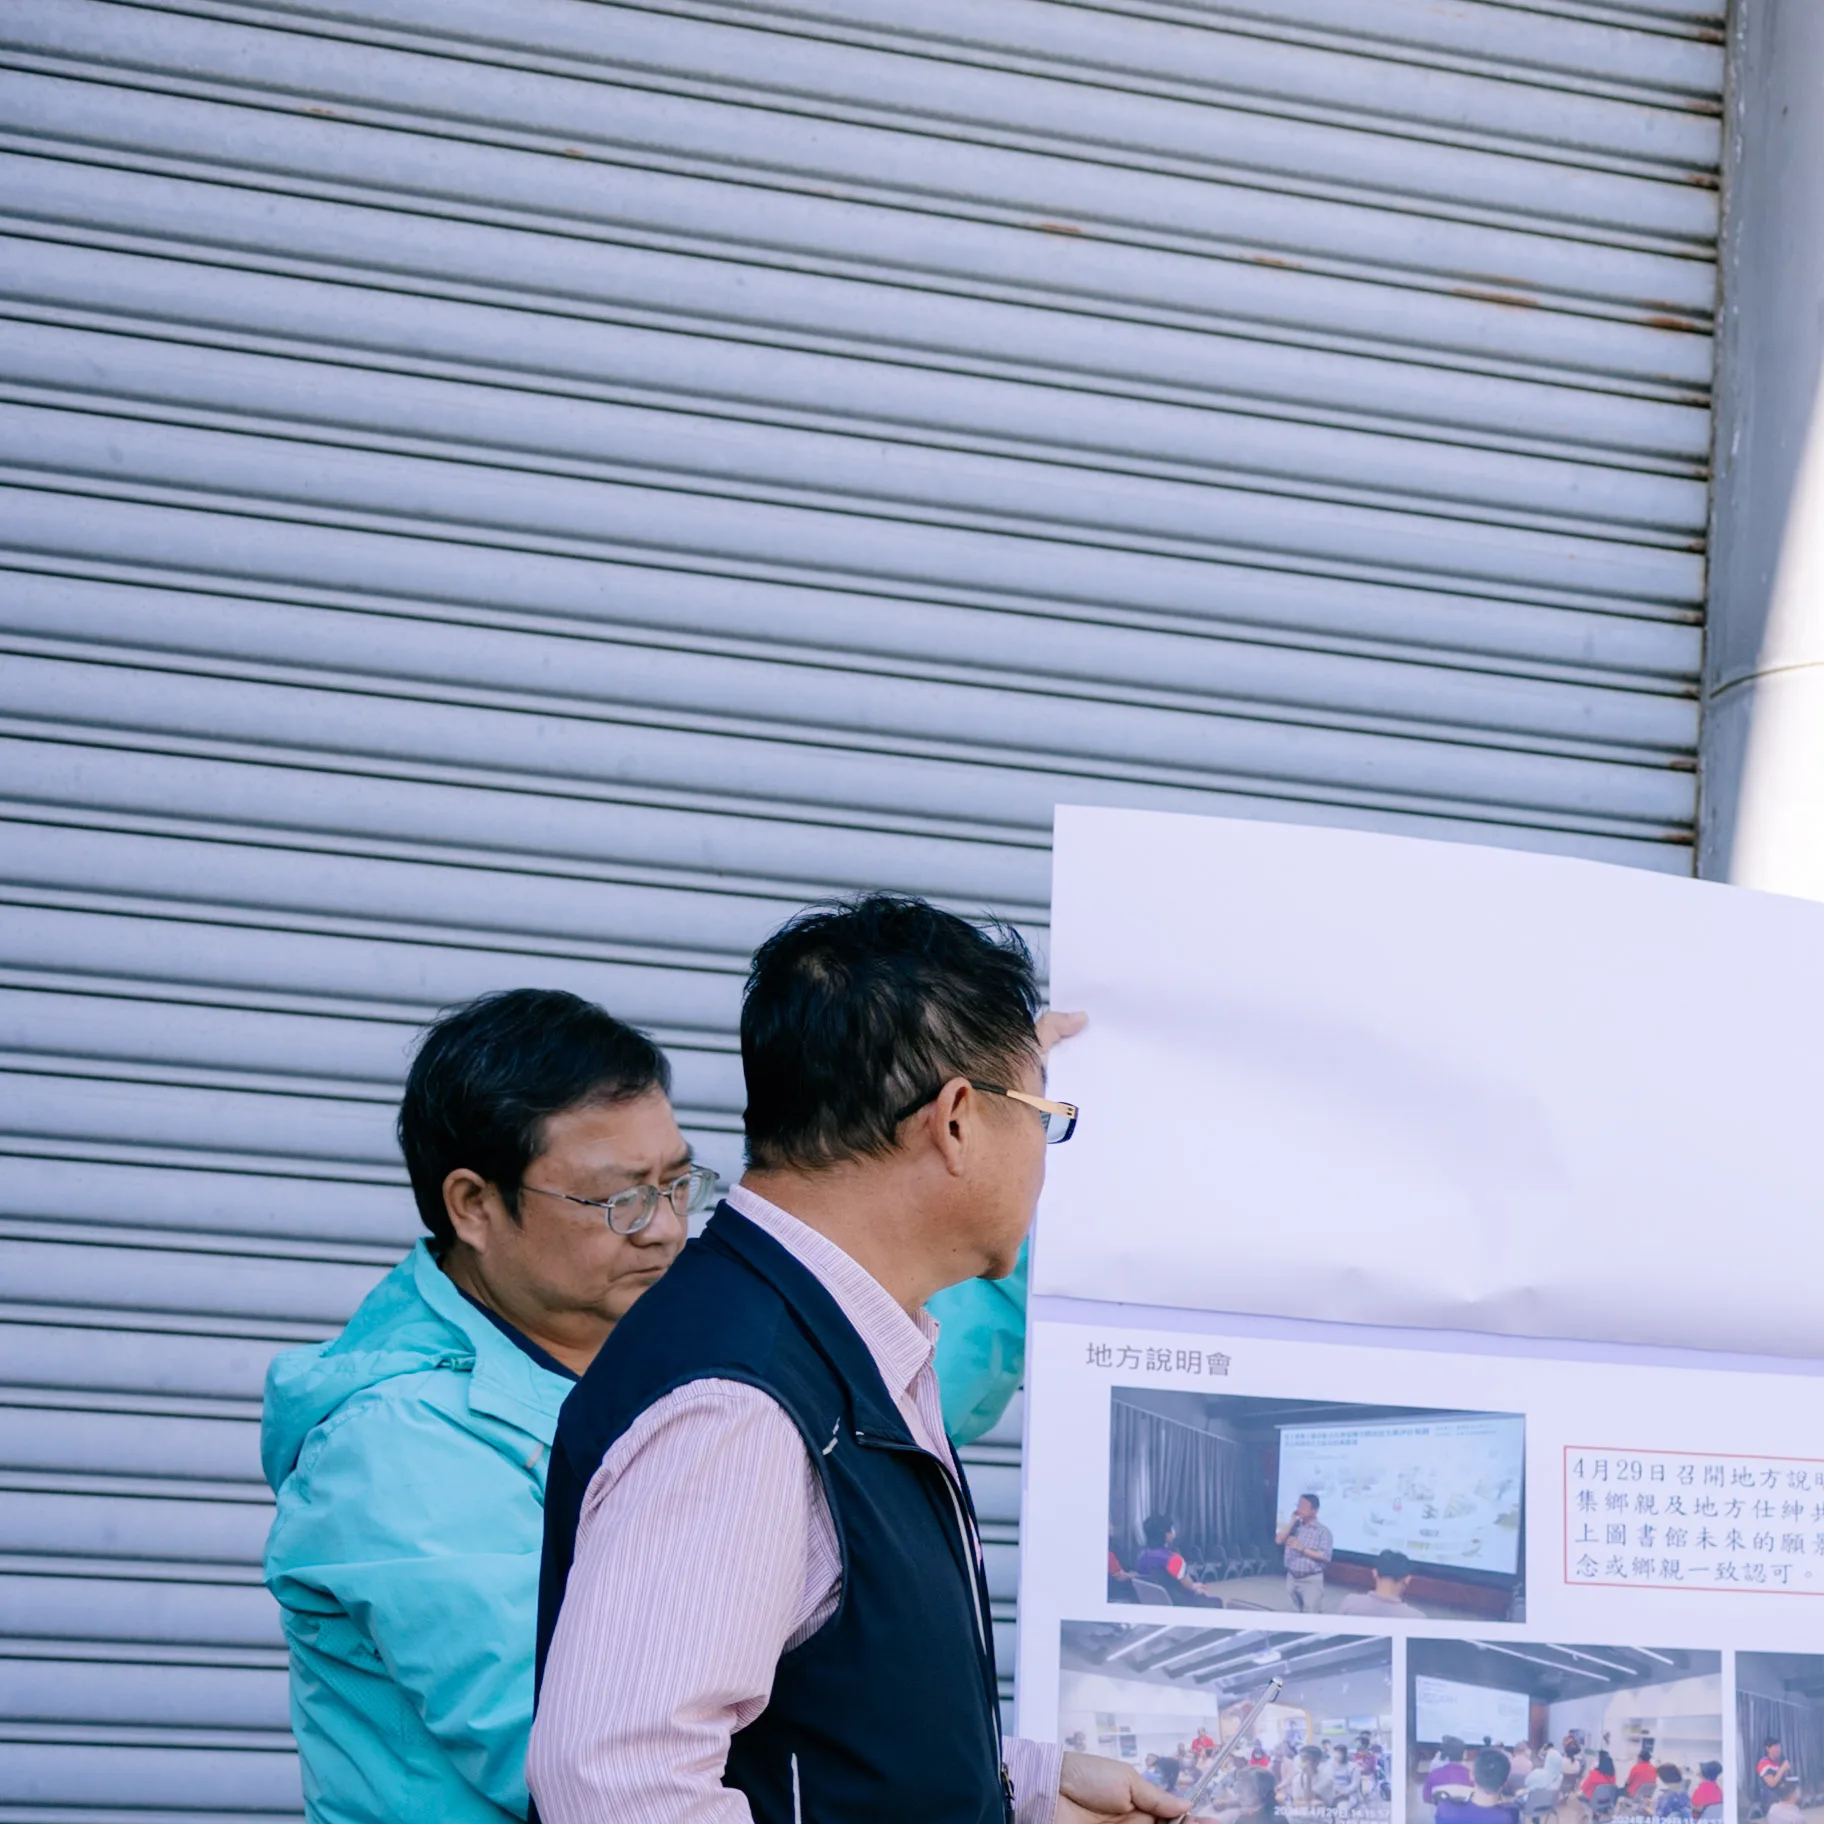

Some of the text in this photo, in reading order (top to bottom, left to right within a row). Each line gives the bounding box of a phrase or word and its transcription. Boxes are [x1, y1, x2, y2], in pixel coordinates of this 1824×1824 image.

[1086, 1342, 1232, 1376] 地方說明會
[1576, 1553, 1813, 1584] 念或鄉親一致認可。
